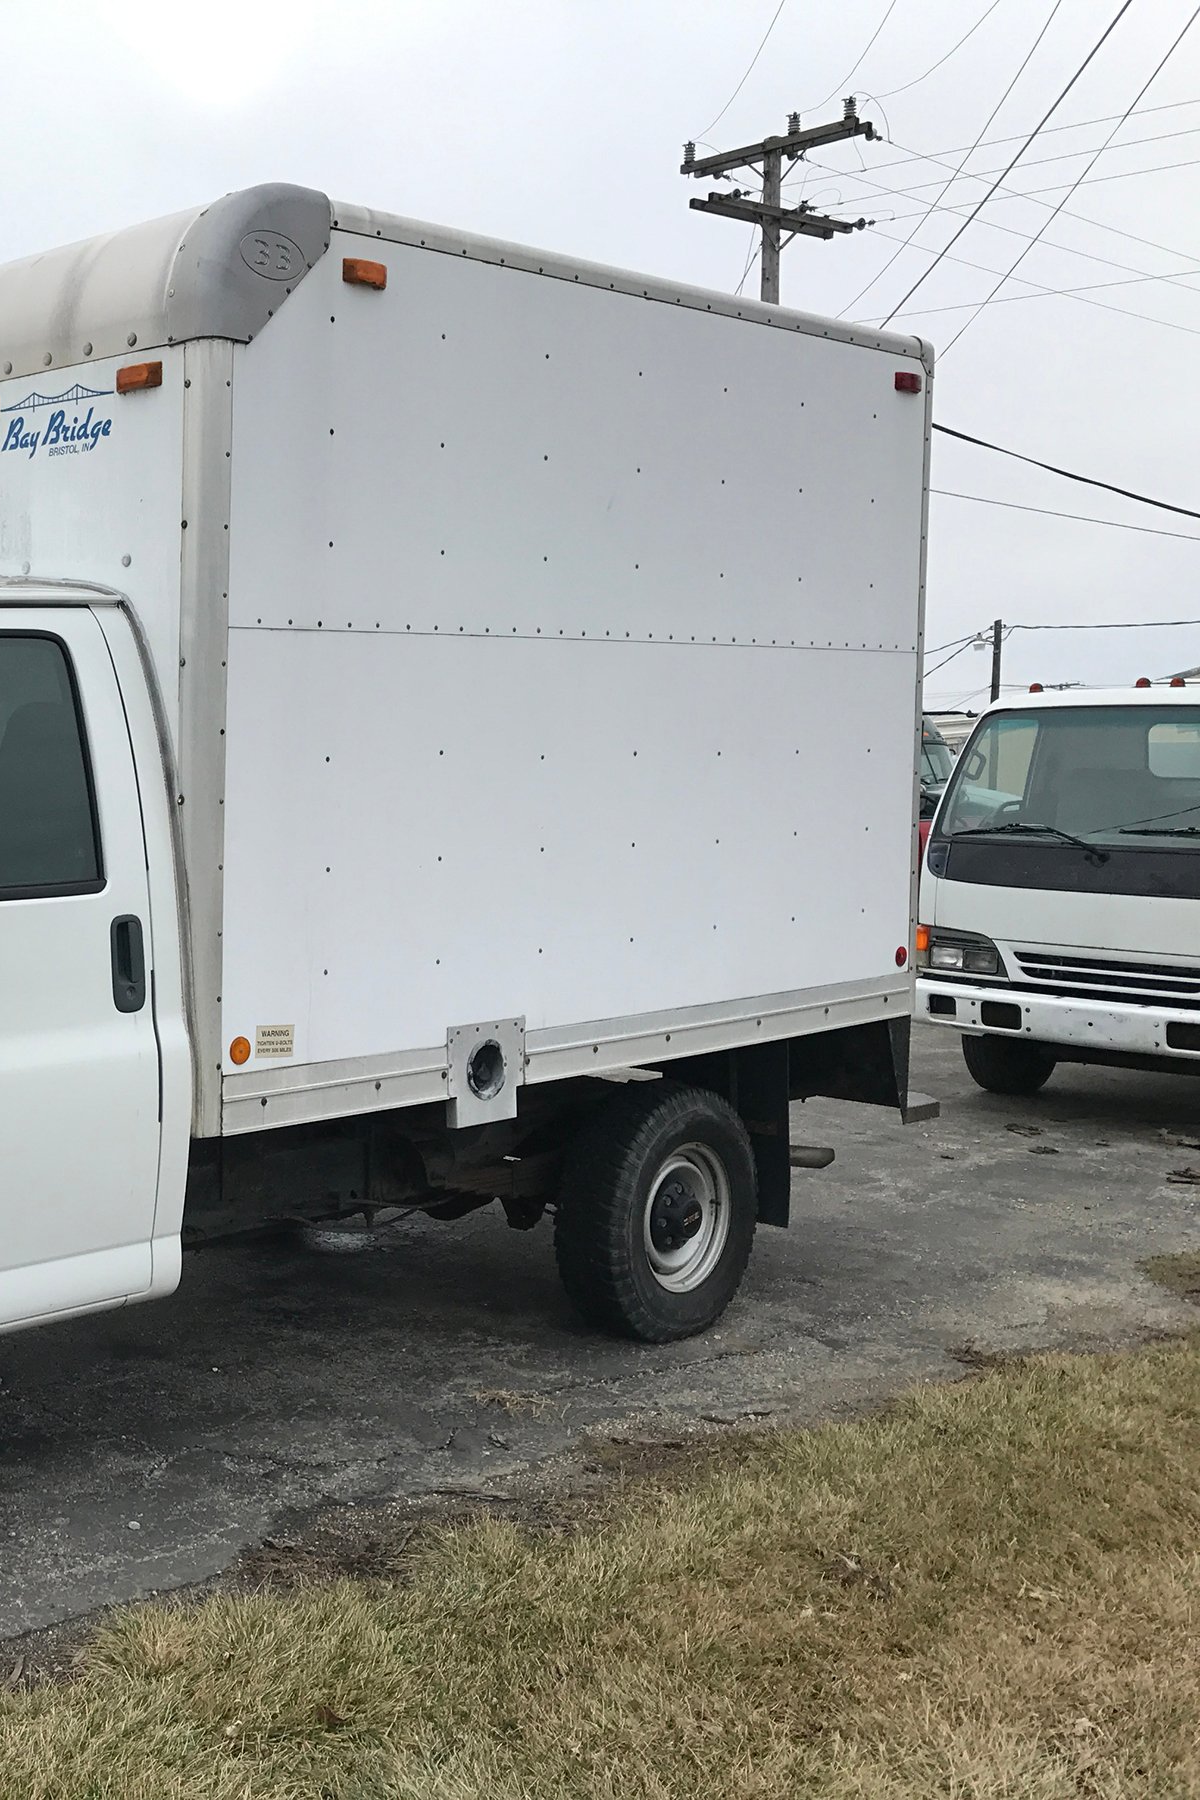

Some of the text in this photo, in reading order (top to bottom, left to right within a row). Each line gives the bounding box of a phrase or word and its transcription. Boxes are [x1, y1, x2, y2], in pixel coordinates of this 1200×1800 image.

[1, 407, 112, 459] Bay Bridge
[48, 442, 90, 457] BRISTOL, IN
[261, 1030, 290, 1038] WARNING
